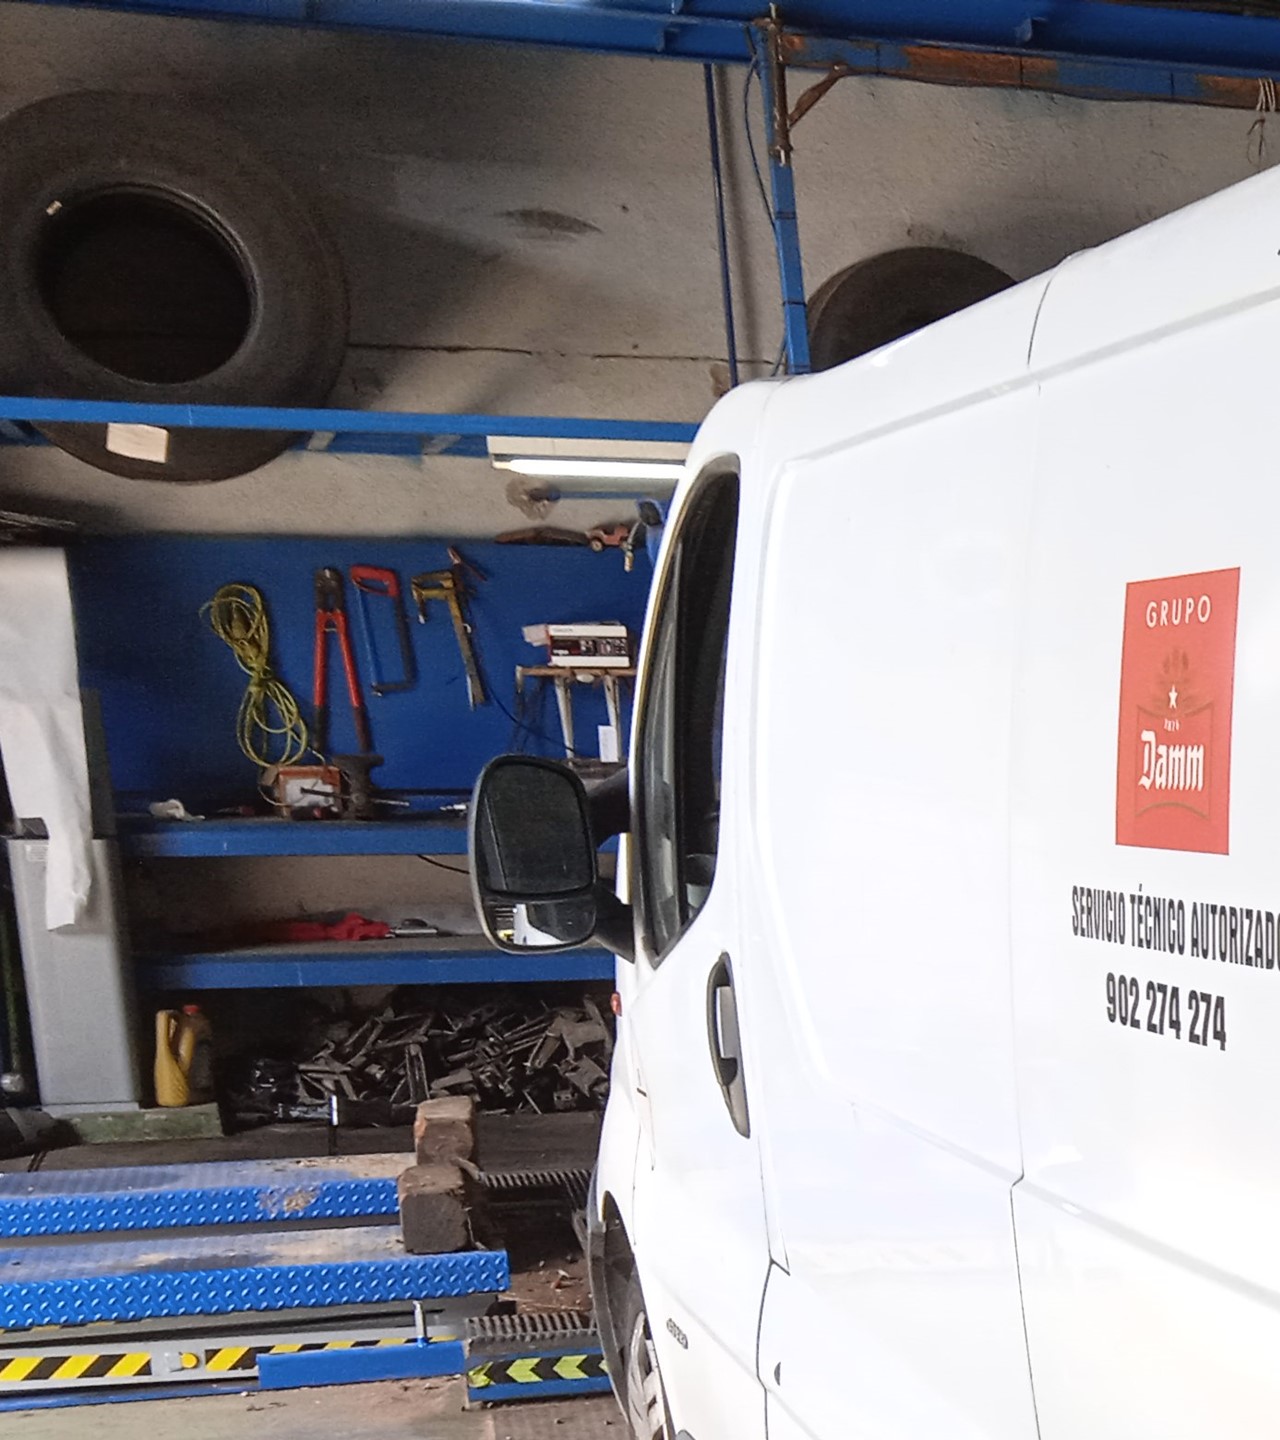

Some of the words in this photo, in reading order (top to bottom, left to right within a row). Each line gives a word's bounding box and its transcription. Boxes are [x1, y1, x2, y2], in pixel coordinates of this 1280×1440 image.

[1146, 595, 1211, 628] GRUPO
[1138, 729, 1204, 791] Damm
[1072, 884, 1126, 945] SERVICIO
[1129, 883, 1185, 955] TÉCNICO
[1106, 972, 1141, 1029] 902
[1146, 980, 1181, 1040] 274
[1188, 989, 1226, 1051] 274
